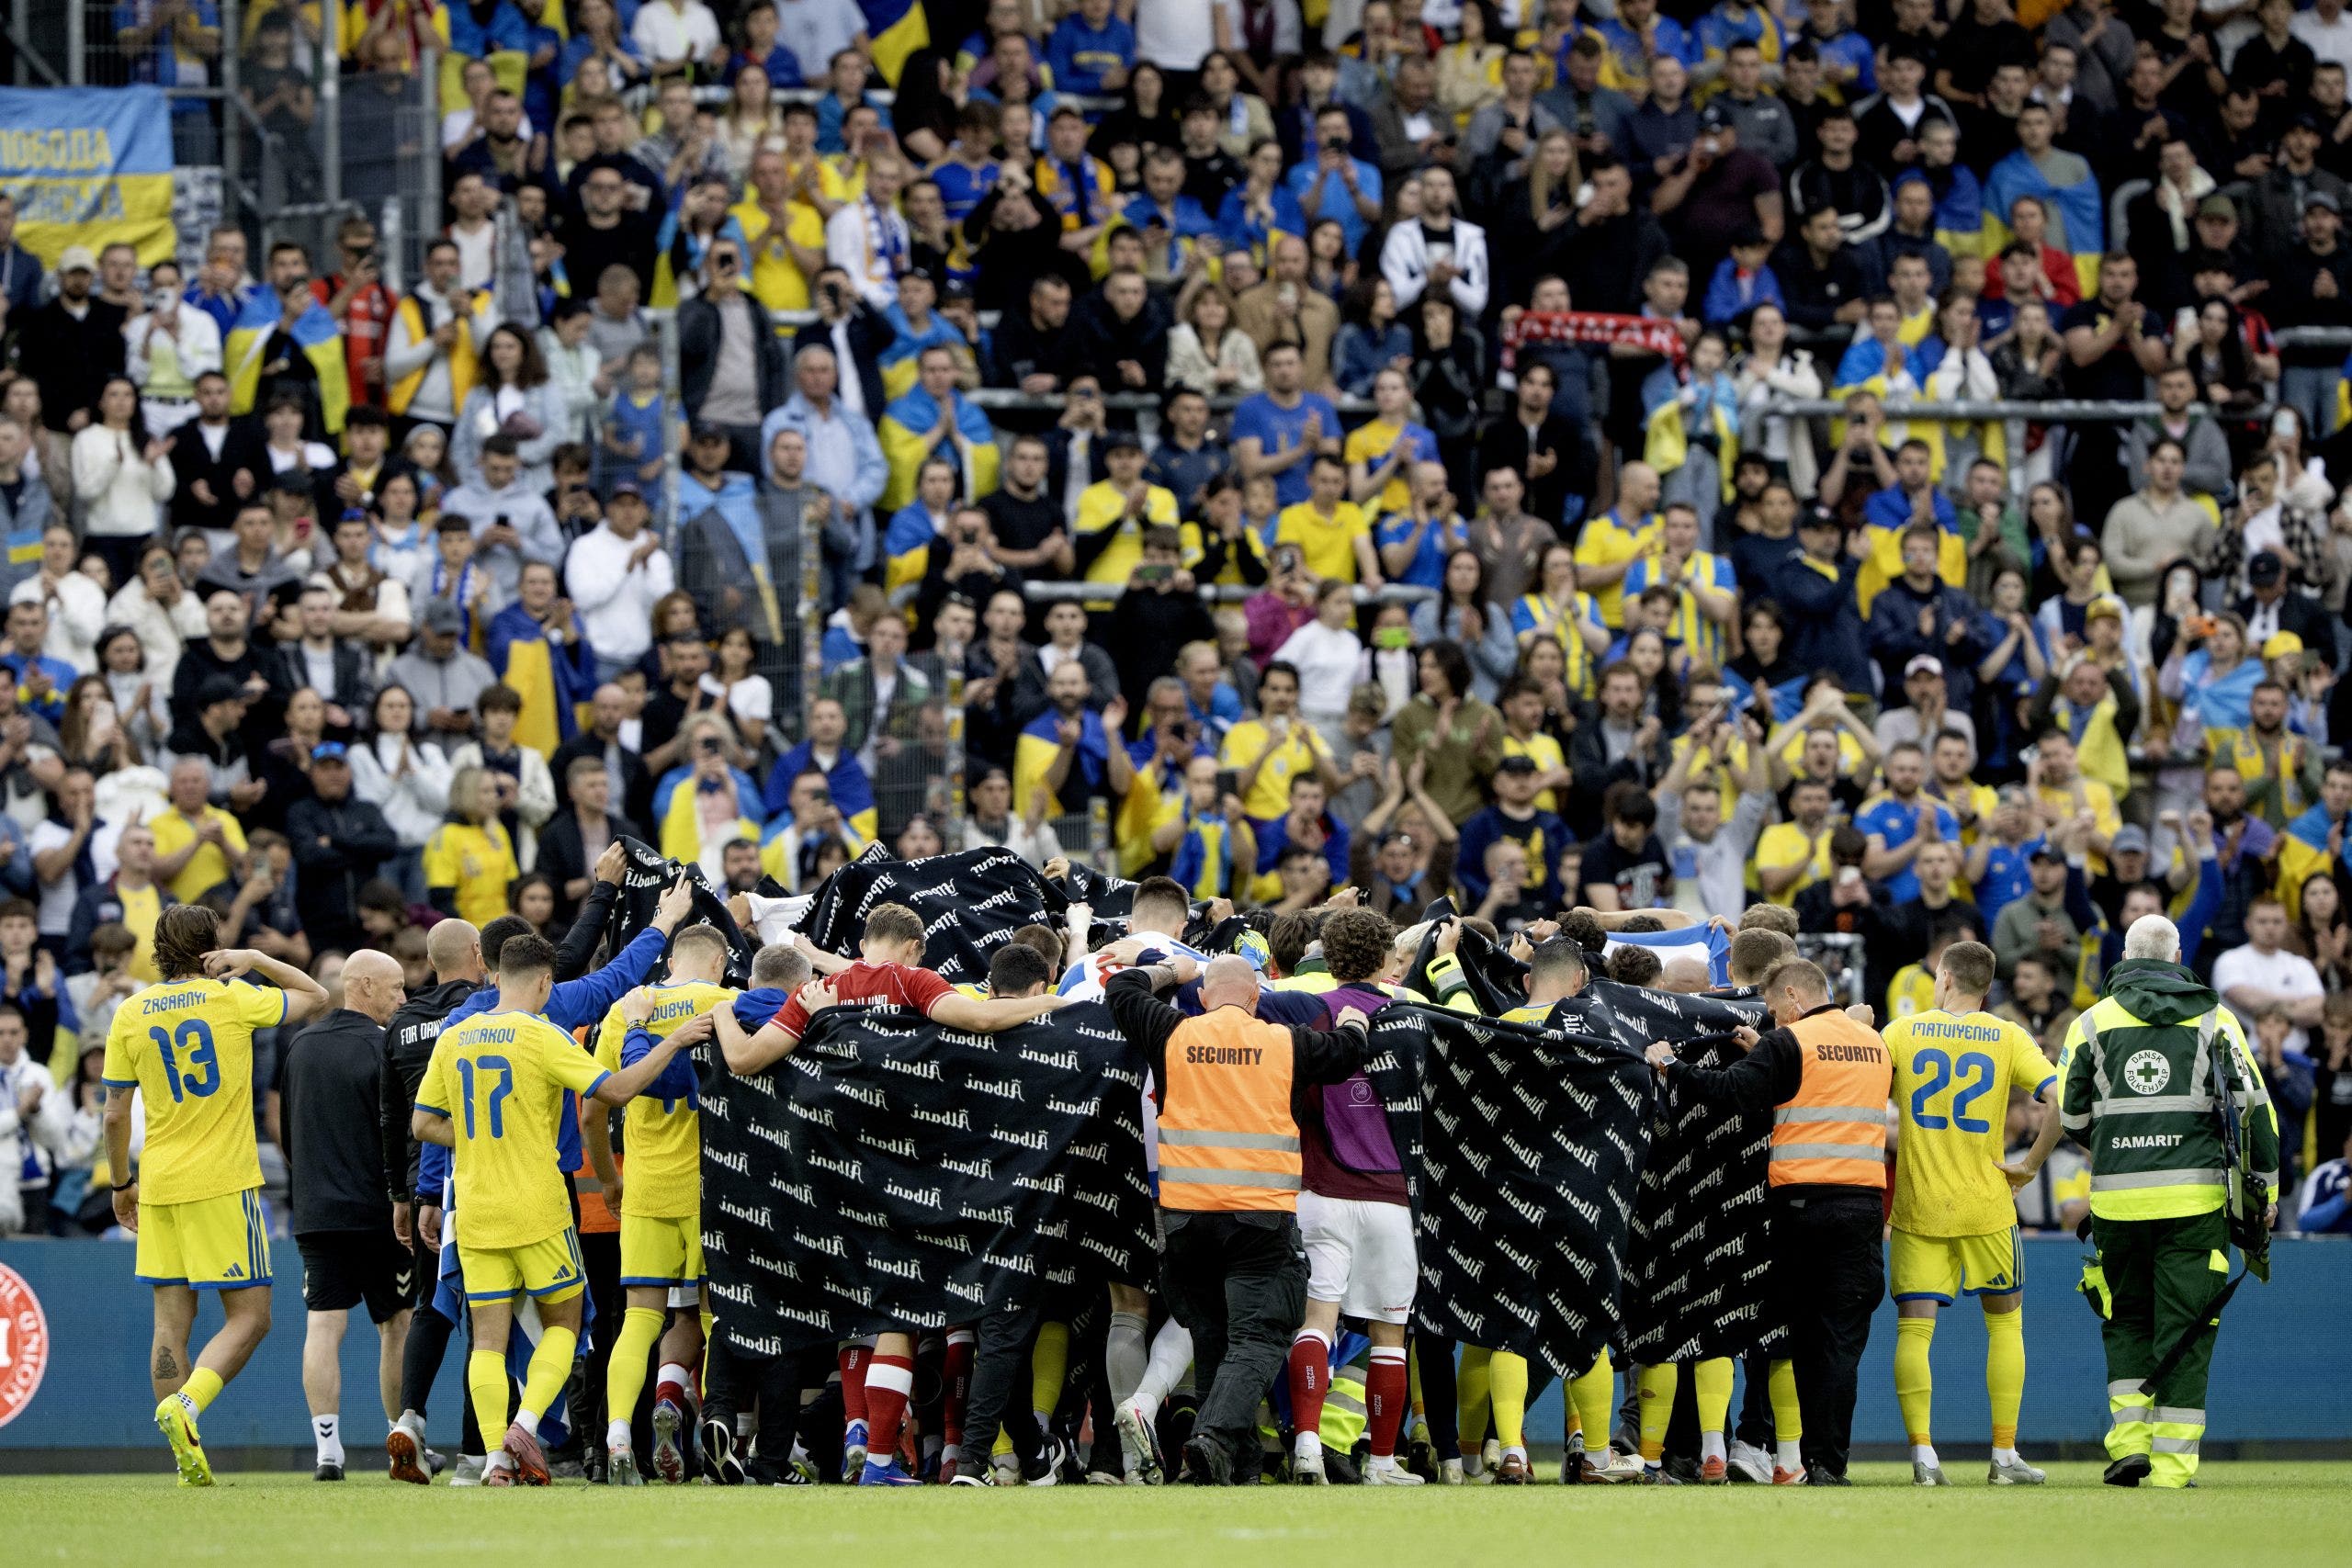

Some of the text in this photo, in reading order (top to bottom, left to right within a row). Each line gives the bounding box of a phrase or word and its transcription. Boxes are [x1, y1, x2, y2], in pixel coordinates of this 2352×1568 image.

[142, 992, 206, 1014] ZABARNYI
[401, 1025, 418, 1045] FOR
[1912, 1022, 2000, 1042] MATVIYENKO
[149, 1019, 220, 1103] 13
[1186, 1045, 1263, 1066] SECURITY
[1816, 1044, 1882, 1064] SECURITY
[2132, 1052, 2164, 1064] DANSK
[2127, 1068, 2168, 1092] FOLKEHJÆLP
[457, 1055, 514, 1140] 17
[1911, 1048, 1996, 1134] 22
[2111, 1134, 2183, 1148] SAMARIT
[4, 1311, 40, 1406] UNION
